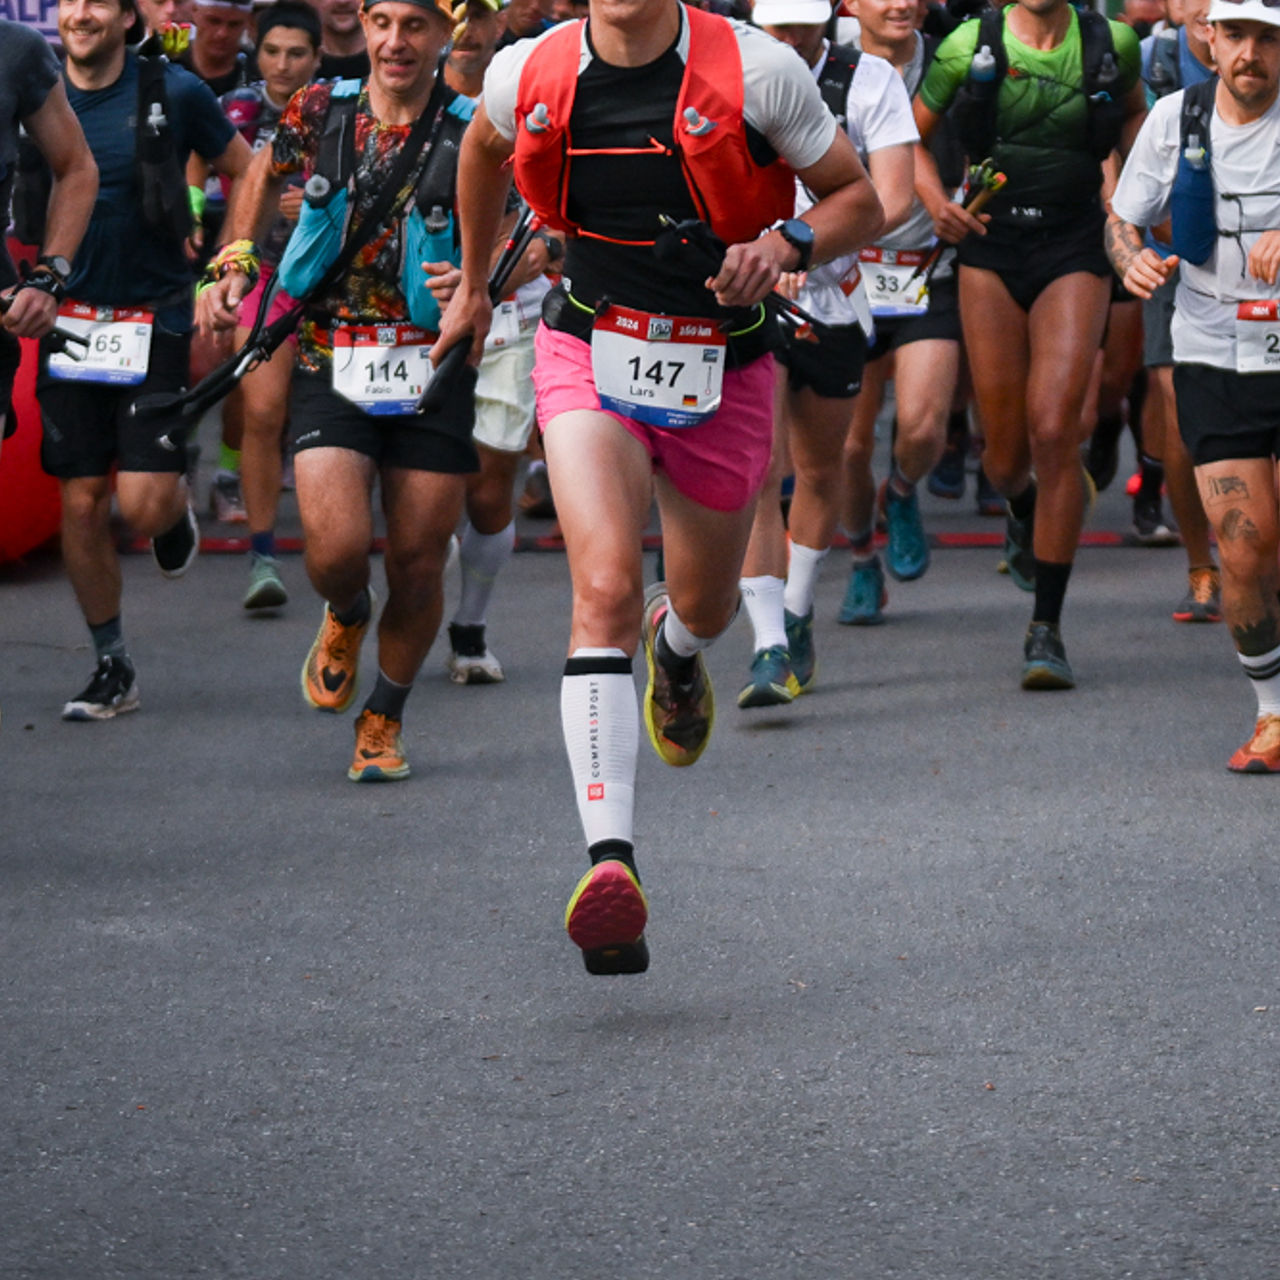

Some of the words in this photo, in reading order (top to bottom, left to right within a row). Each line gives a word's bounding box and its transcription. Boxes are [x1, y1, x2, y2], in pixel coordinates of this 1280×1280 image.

[875, 274, 900, 293] 33
[364, 359, 409, 383] 114
[627, 355, 686, 390] 147
[629, 384, 656, 399] Lars
[589, 681, 601, 778] COMPRESSPORT
